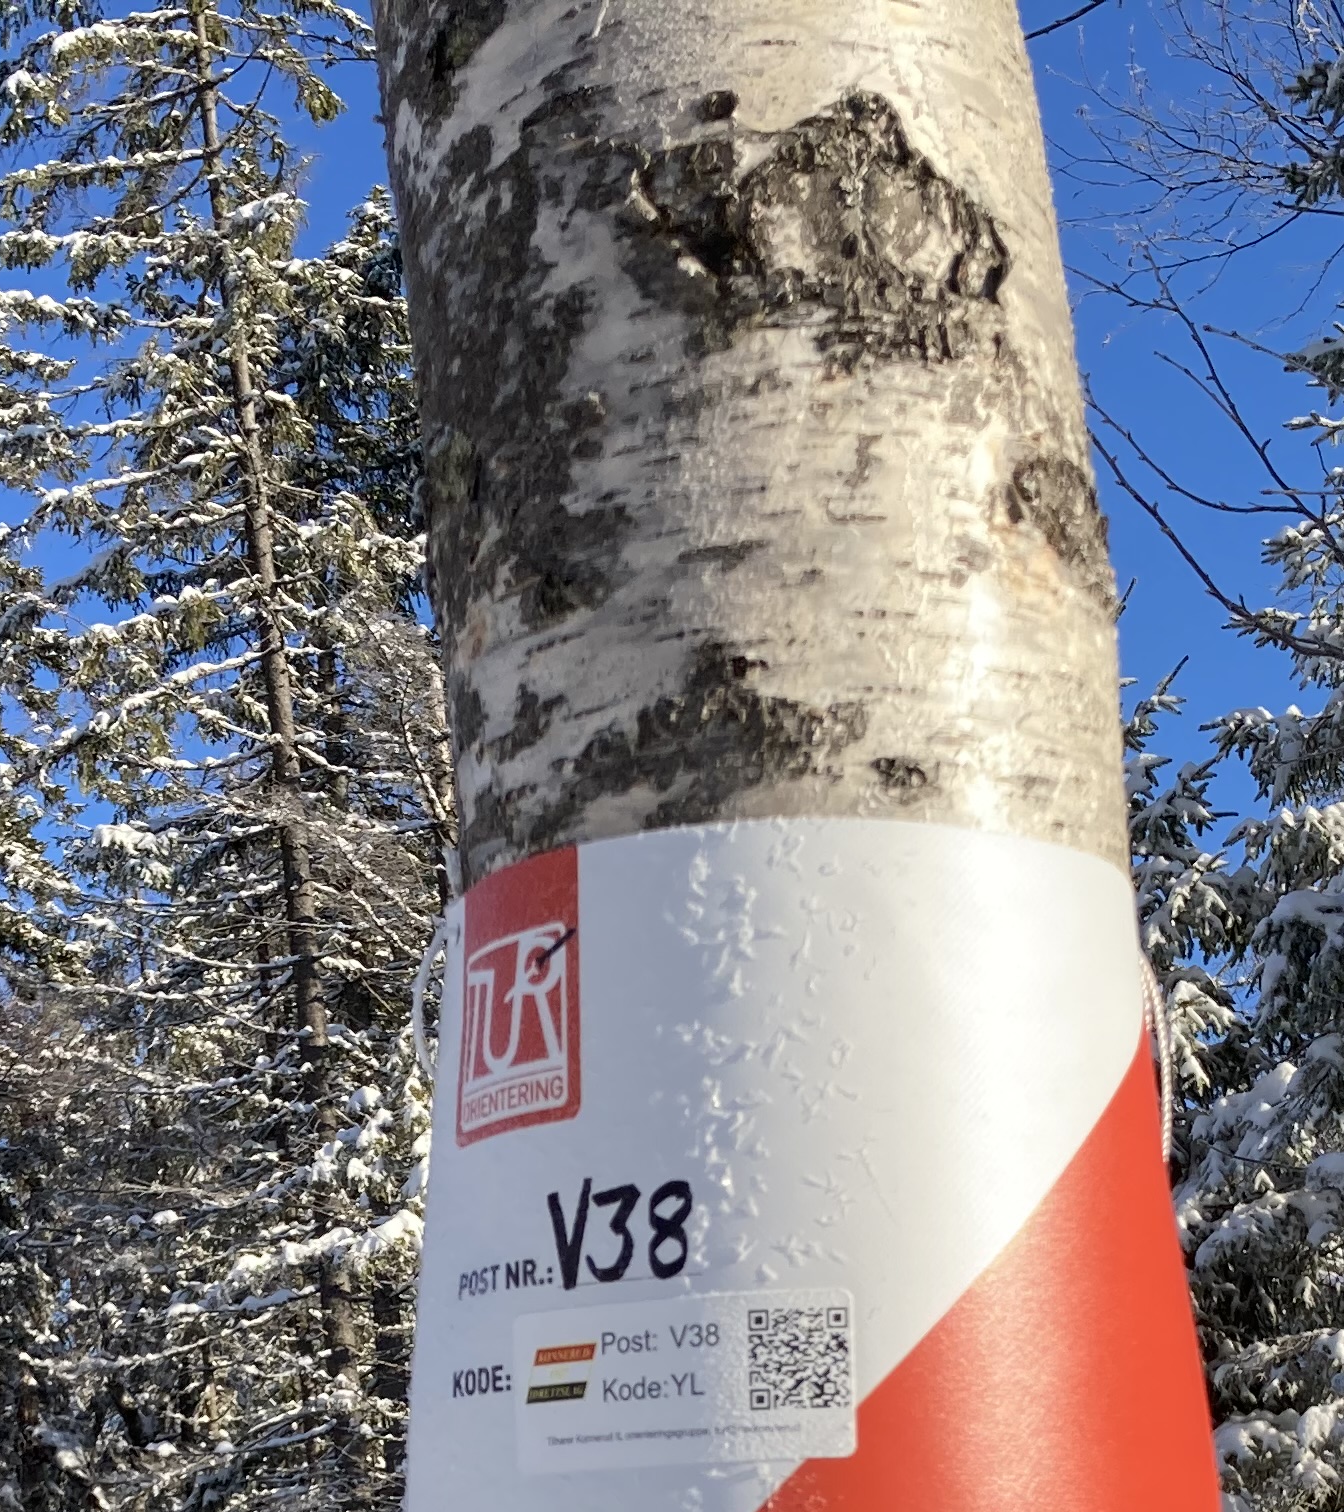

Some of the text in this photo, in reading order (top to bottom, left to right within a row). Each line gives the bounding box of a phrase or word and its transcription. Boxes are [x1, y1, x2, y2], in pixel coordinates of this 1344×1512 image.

[462, 1075, 564, 1123] ORIENTERING
[547, 1177, 692, 1290] V38
[458, 1259, 553, 1300] POST NR.:
[601, 1323, 720, 1355] Post: V38
[452, 1364, 511, 1398] KODE:
[602, 1371, 705, 1402] Kode: YL
